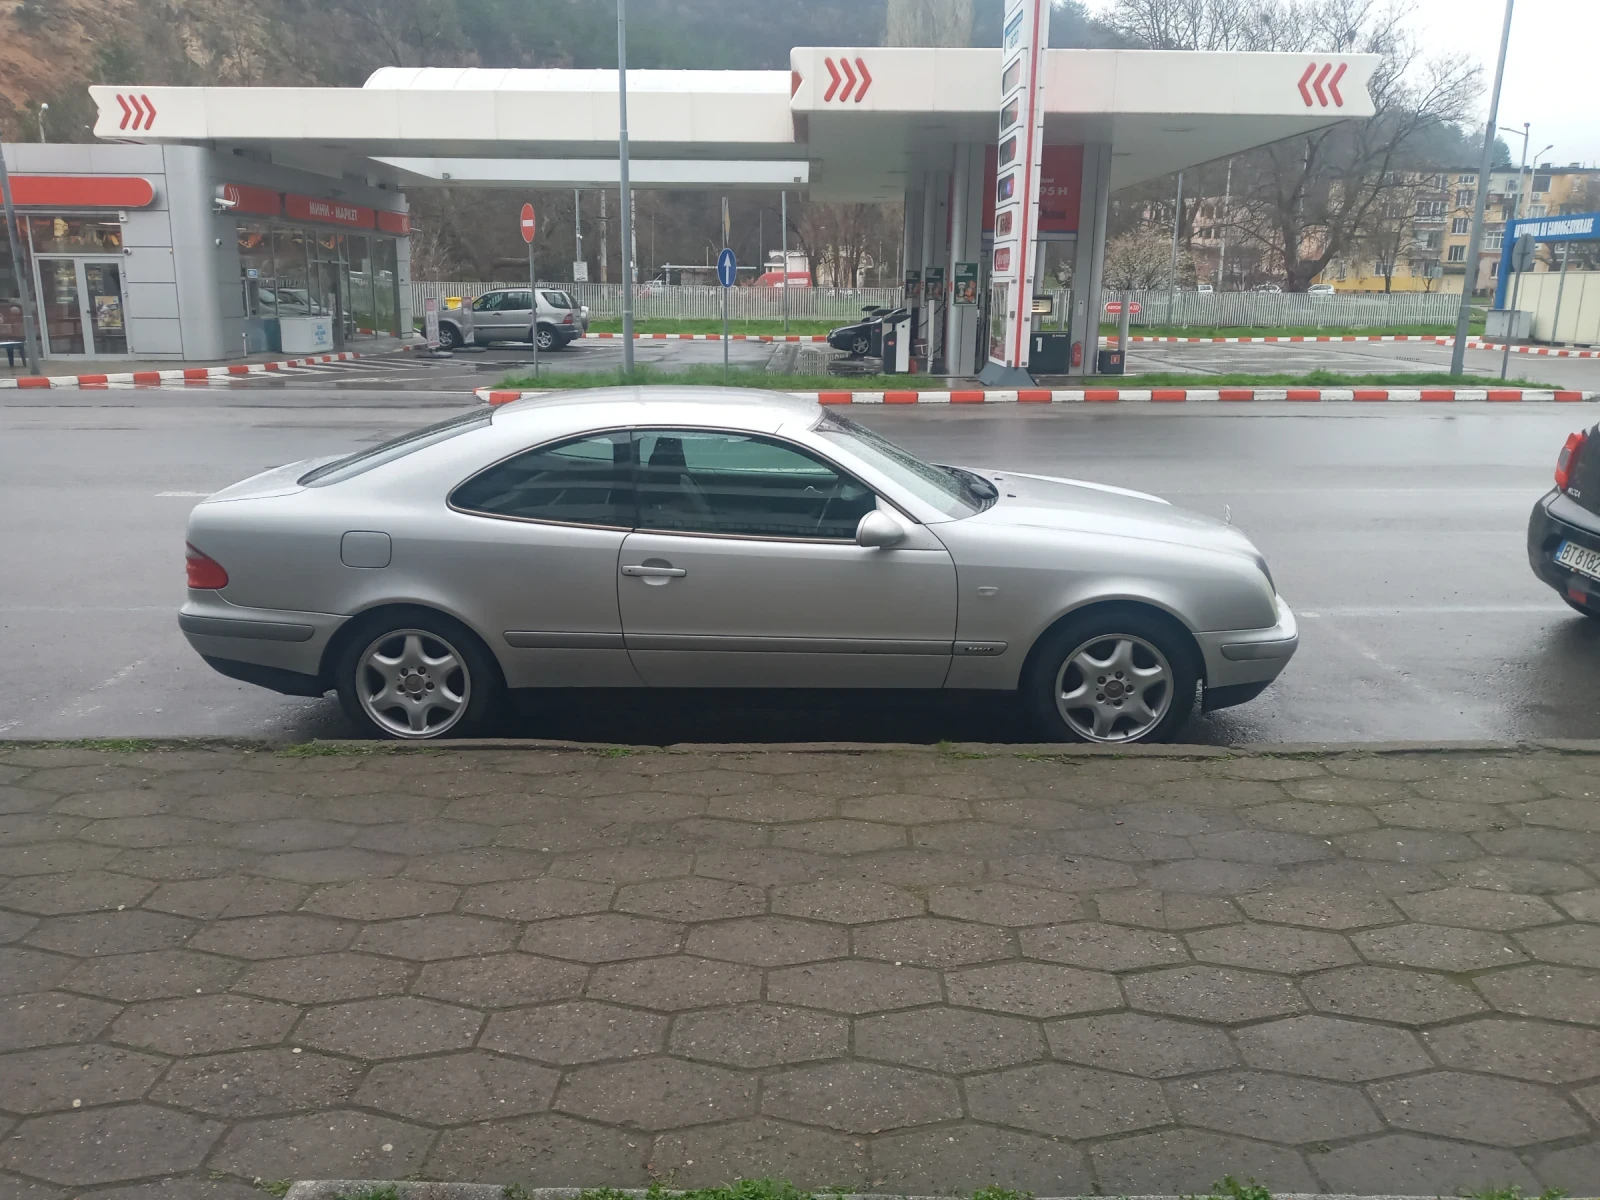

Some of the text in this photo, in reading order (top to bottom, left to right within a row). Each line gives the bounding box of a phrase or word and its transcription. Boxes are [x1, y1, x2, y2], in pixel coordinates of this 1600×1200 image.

[309, 202, 330, 217] МИНИ
[335, 206, 358, 221] МАРКЕТ
[1036, 337, 1042, 352] 1
[1561, 544, 1600, 575] BT8182
